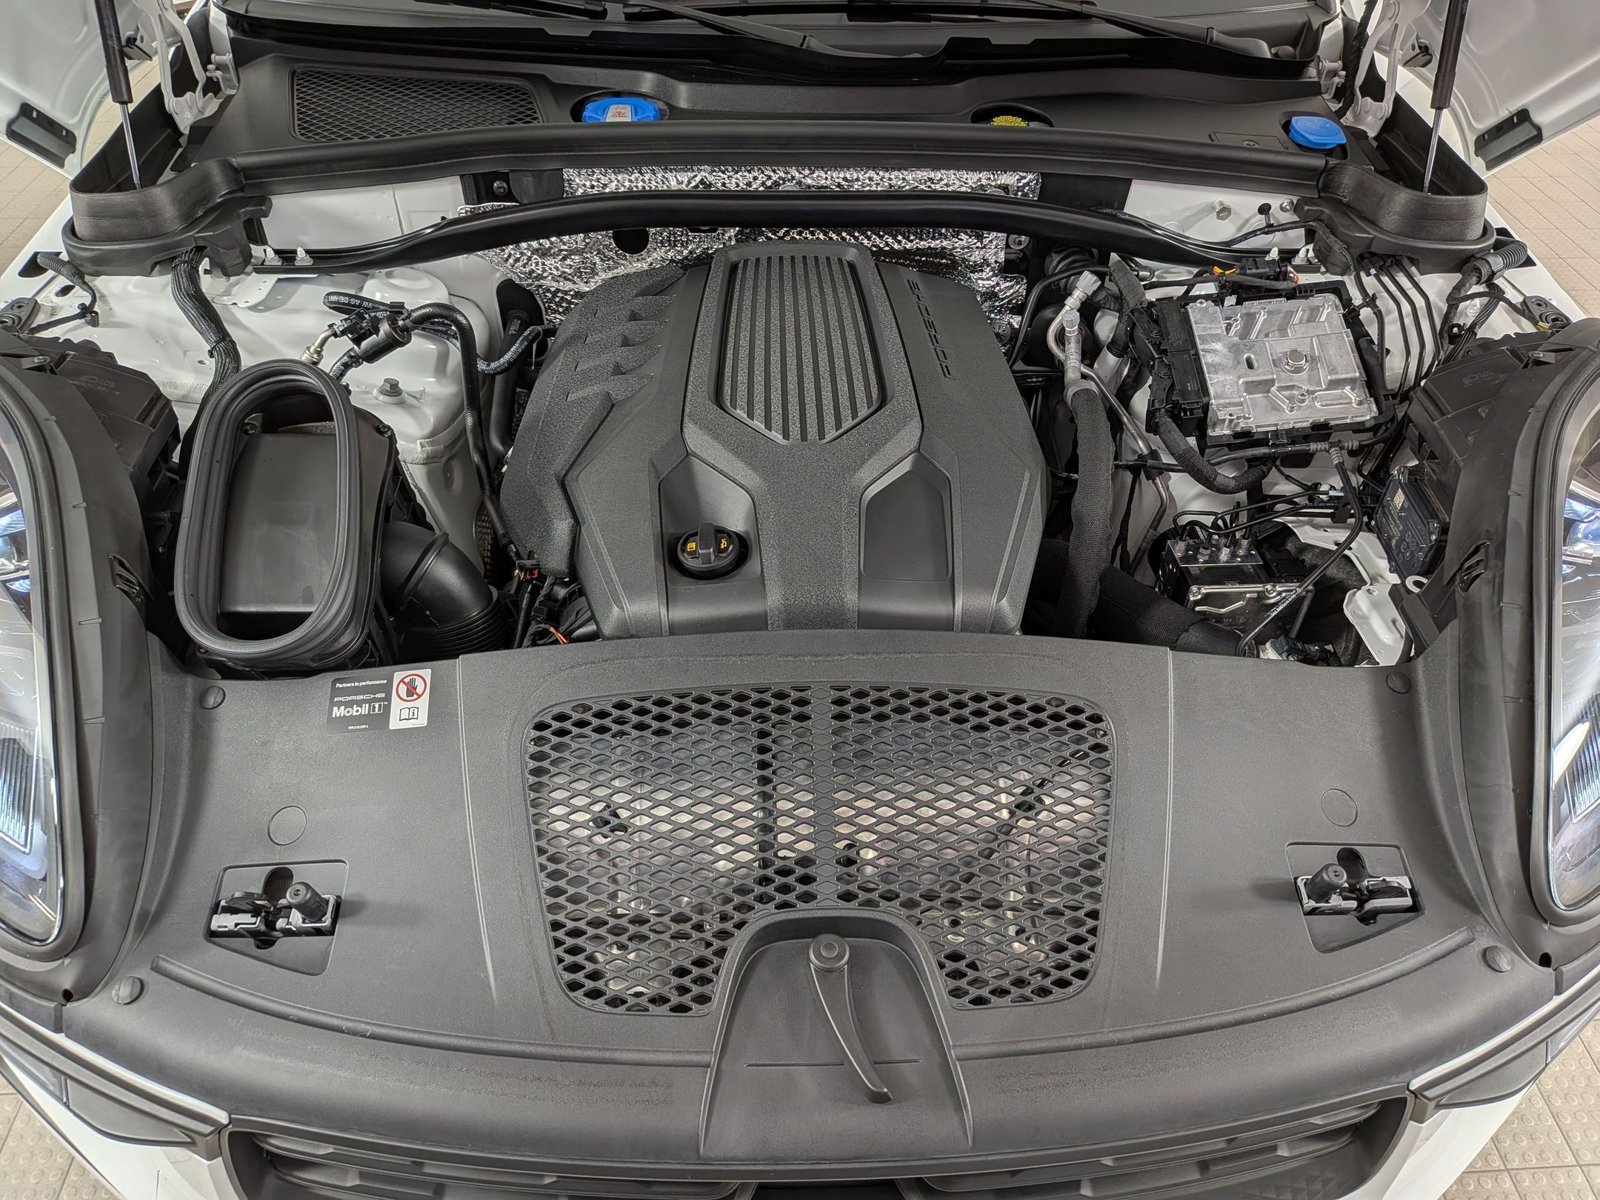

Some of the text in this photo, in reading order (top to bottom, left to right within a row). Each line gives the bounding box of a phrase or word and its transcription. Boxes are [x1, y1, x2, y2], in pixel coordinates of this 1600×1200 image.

[906, 279, 956, 380] PORSCHE
[360, 679, 388, 687] performance
[333, 692, 386, 702] PORSCHE
[331, 703, 370, 718] Mobil
